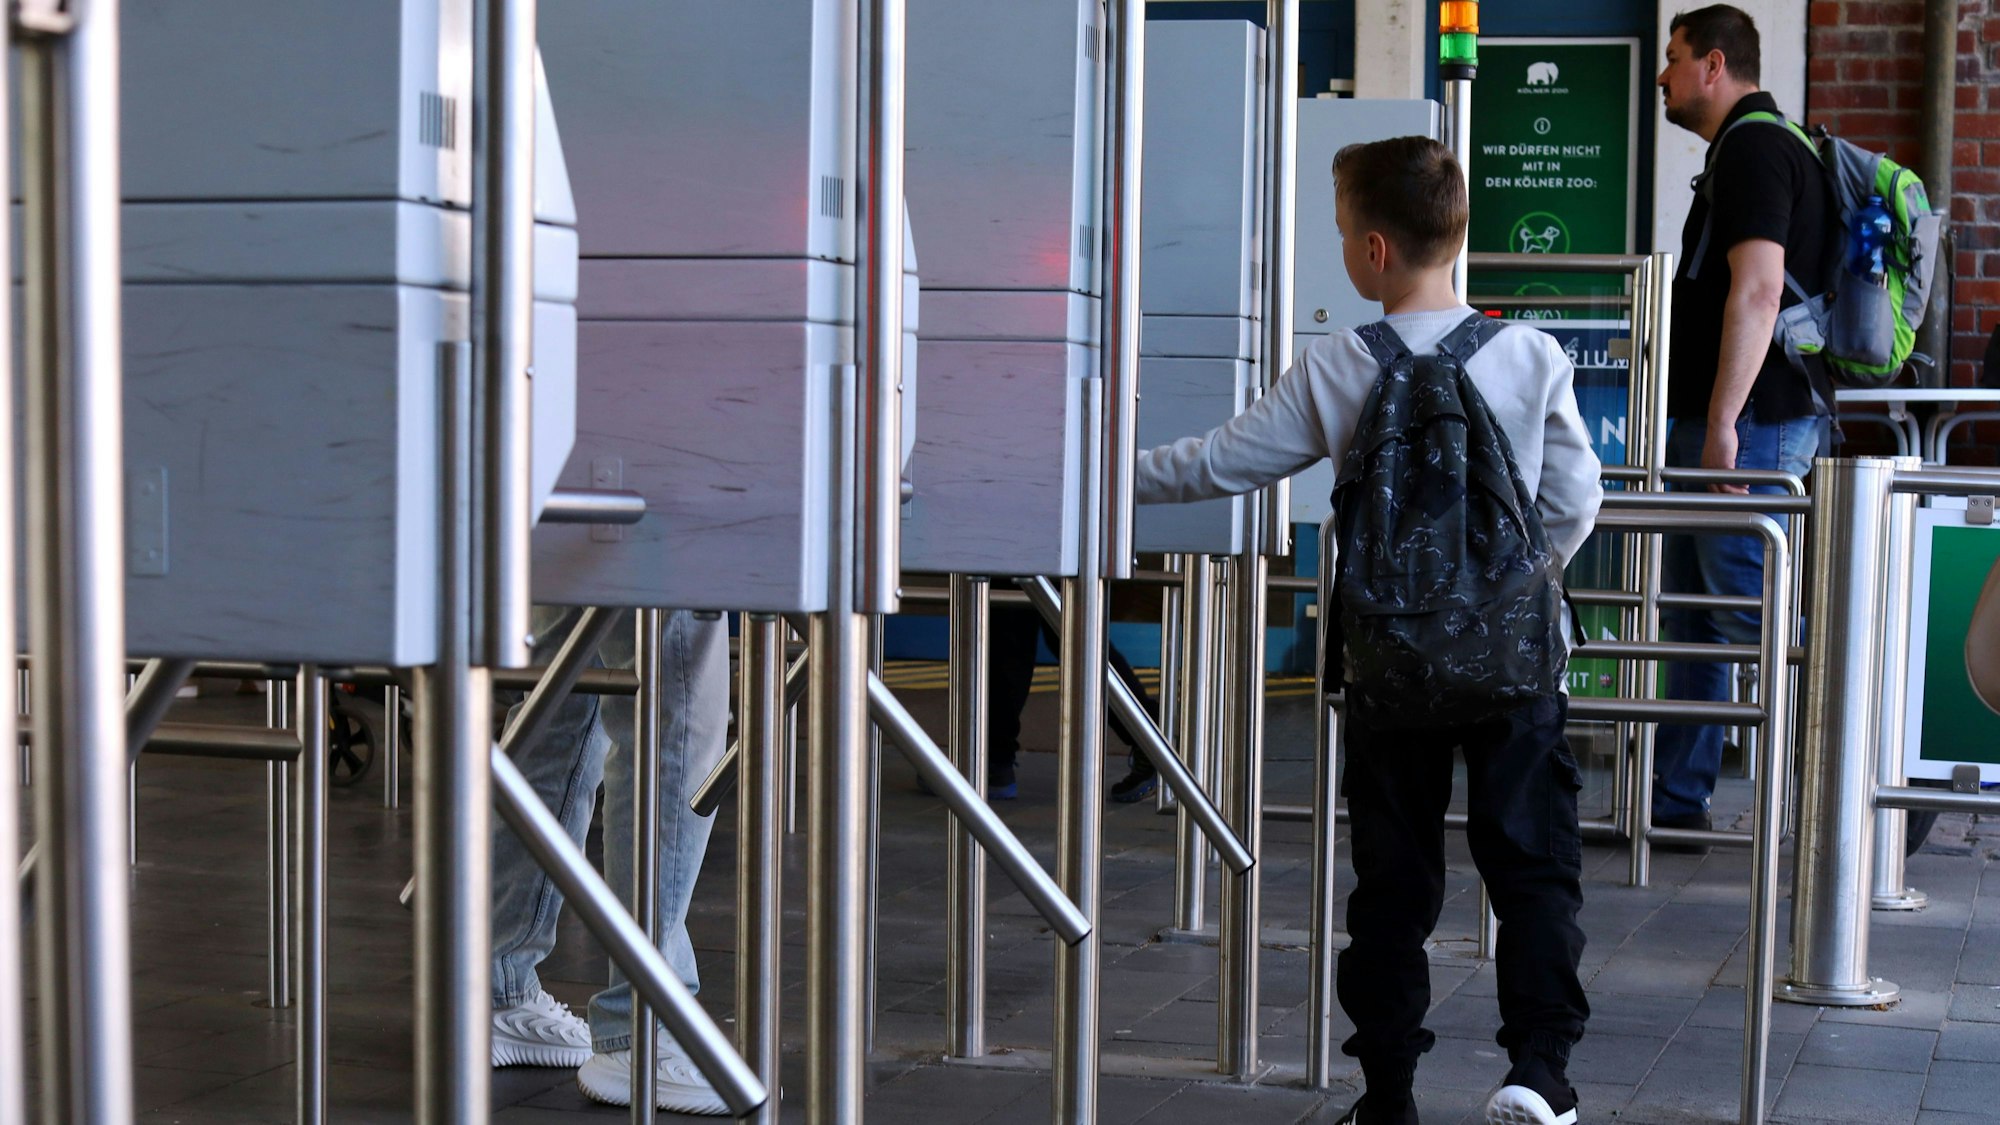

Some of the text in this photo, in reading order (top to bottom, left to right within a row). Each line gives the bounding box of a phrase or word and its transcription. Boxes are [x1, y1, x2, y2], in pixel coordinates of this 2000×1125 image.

[1483, 143, 1601, 155] WIR DÜRFEN NICHT
[1522, 162, 1560, 171] MIT IN
[1485, 176, 1597, 188] DEN KÖLNER ZOO:
